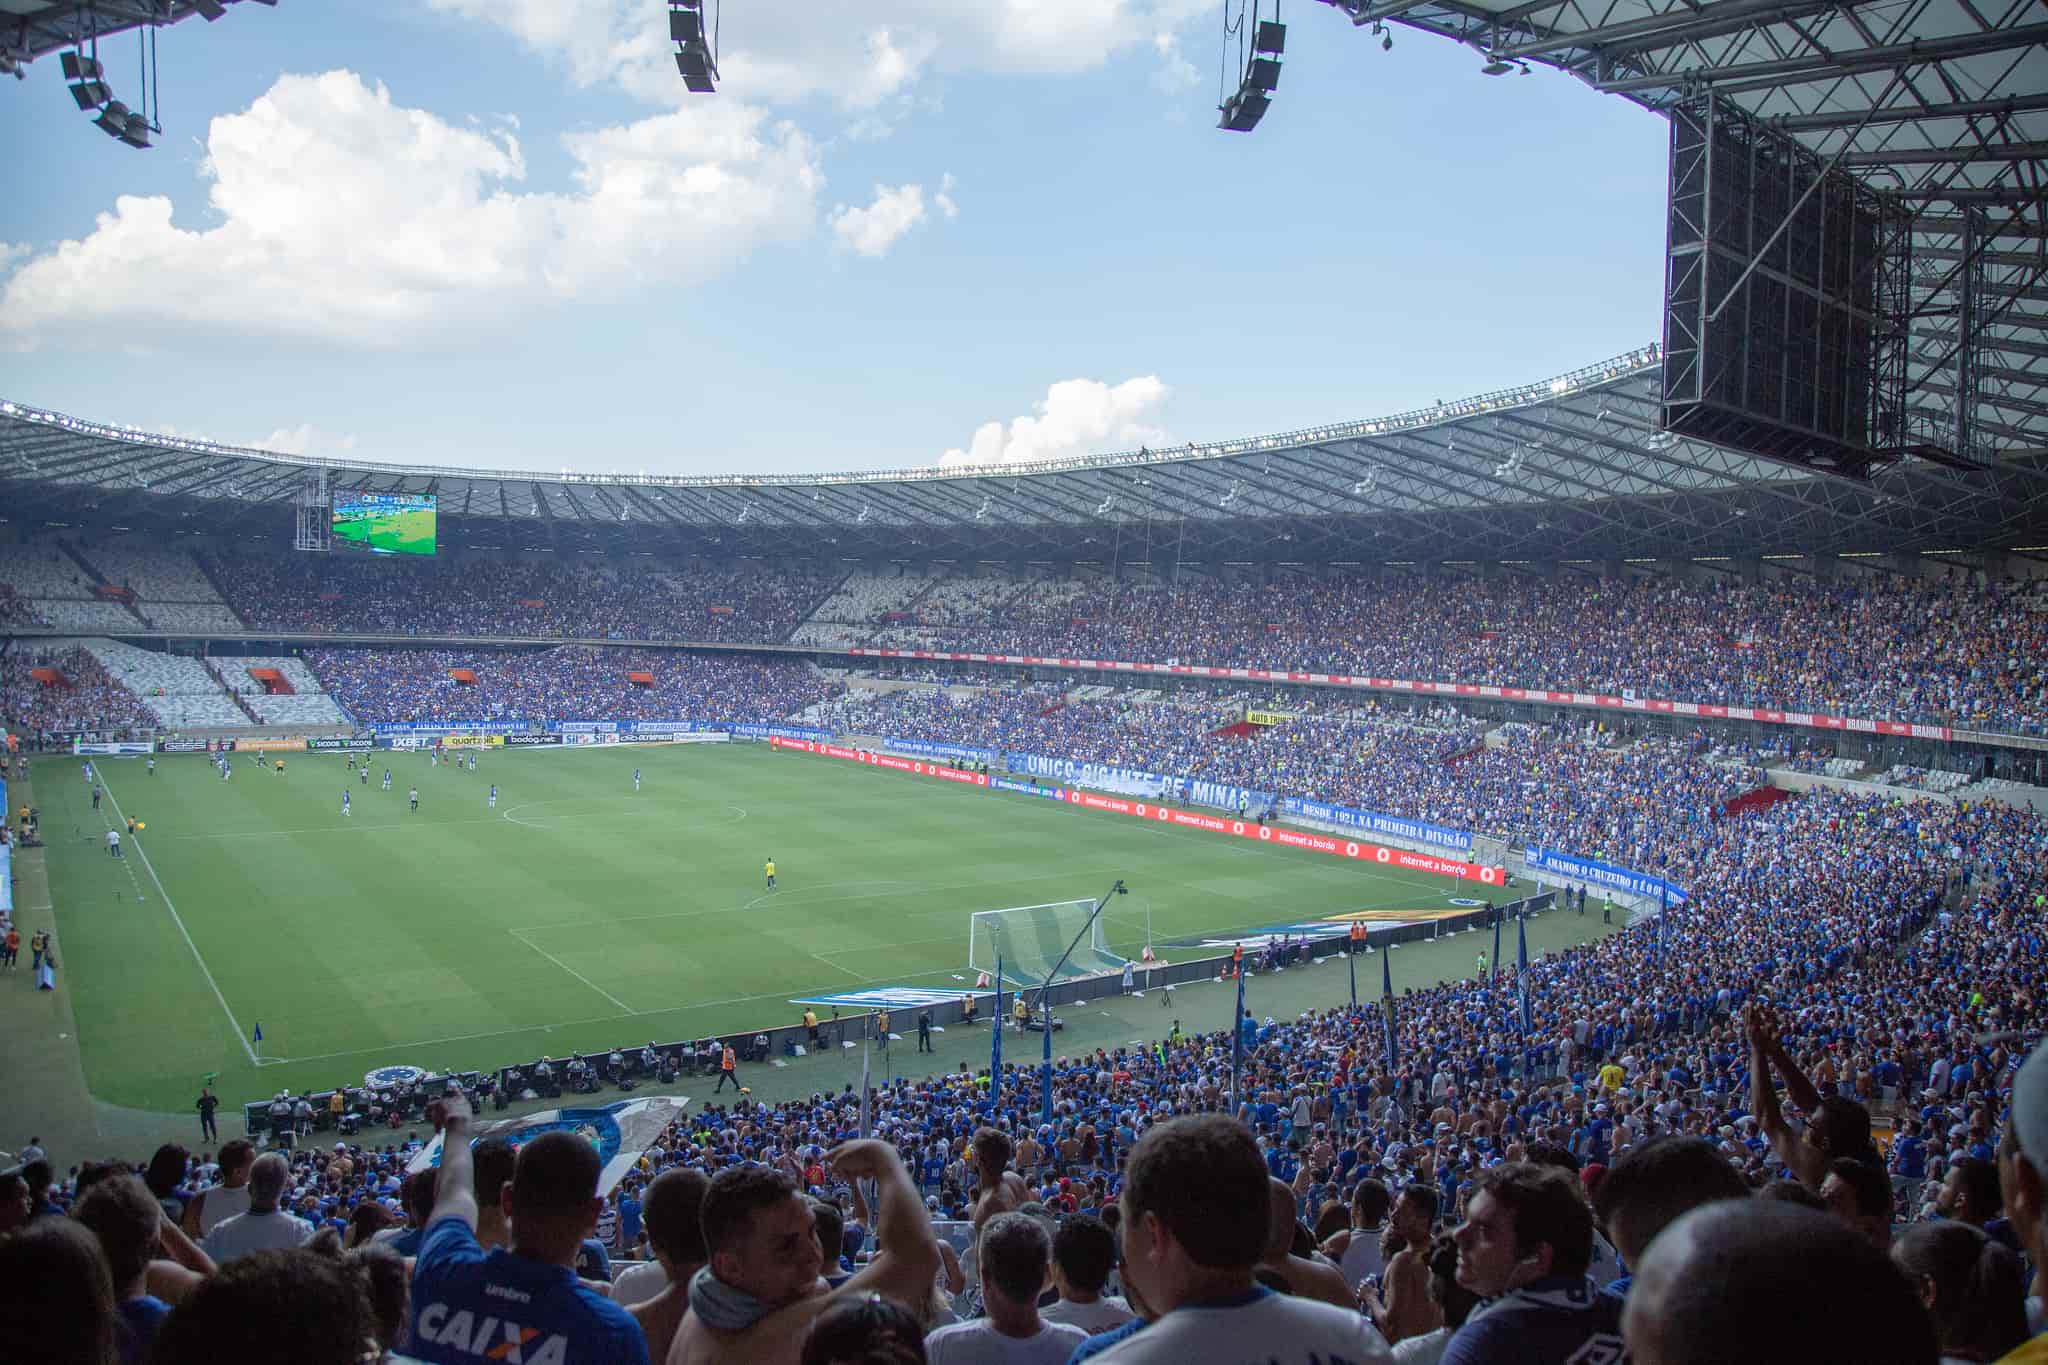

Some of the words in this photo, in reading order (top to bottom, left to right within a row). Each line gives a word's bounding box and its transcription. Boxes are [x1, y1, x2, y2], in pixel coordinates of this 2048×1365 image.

[1846, 719, 1876, 731] BRAHMA
[1911, 725, 1943, 738] BRAHMA
[1303, 804, 1332, 818] DESDE
[1335, 811, 1355, 825] 1921
[1358, 815, 1371, 828] NA
[1374, 818, 1423, 838] PRIMEIRA
[1426, 829, 1468, 848] DIVISÃO
[1280, 832, 1307, 846] Internet
[1313, 839, 1335, 850] bordo
[1400, 855, 1433, 869] Internet
[1441, 862, 1467, 875] bordo
[1546, 856, 1580, 874] AMAMOS
[1581, 866, 1587, 874] O
[1589, 867, 1631, 887] CRUZEIRO
[486, 1283, 531, 1304] umbro
[418, 1303, 569, 1365] CAIXA
